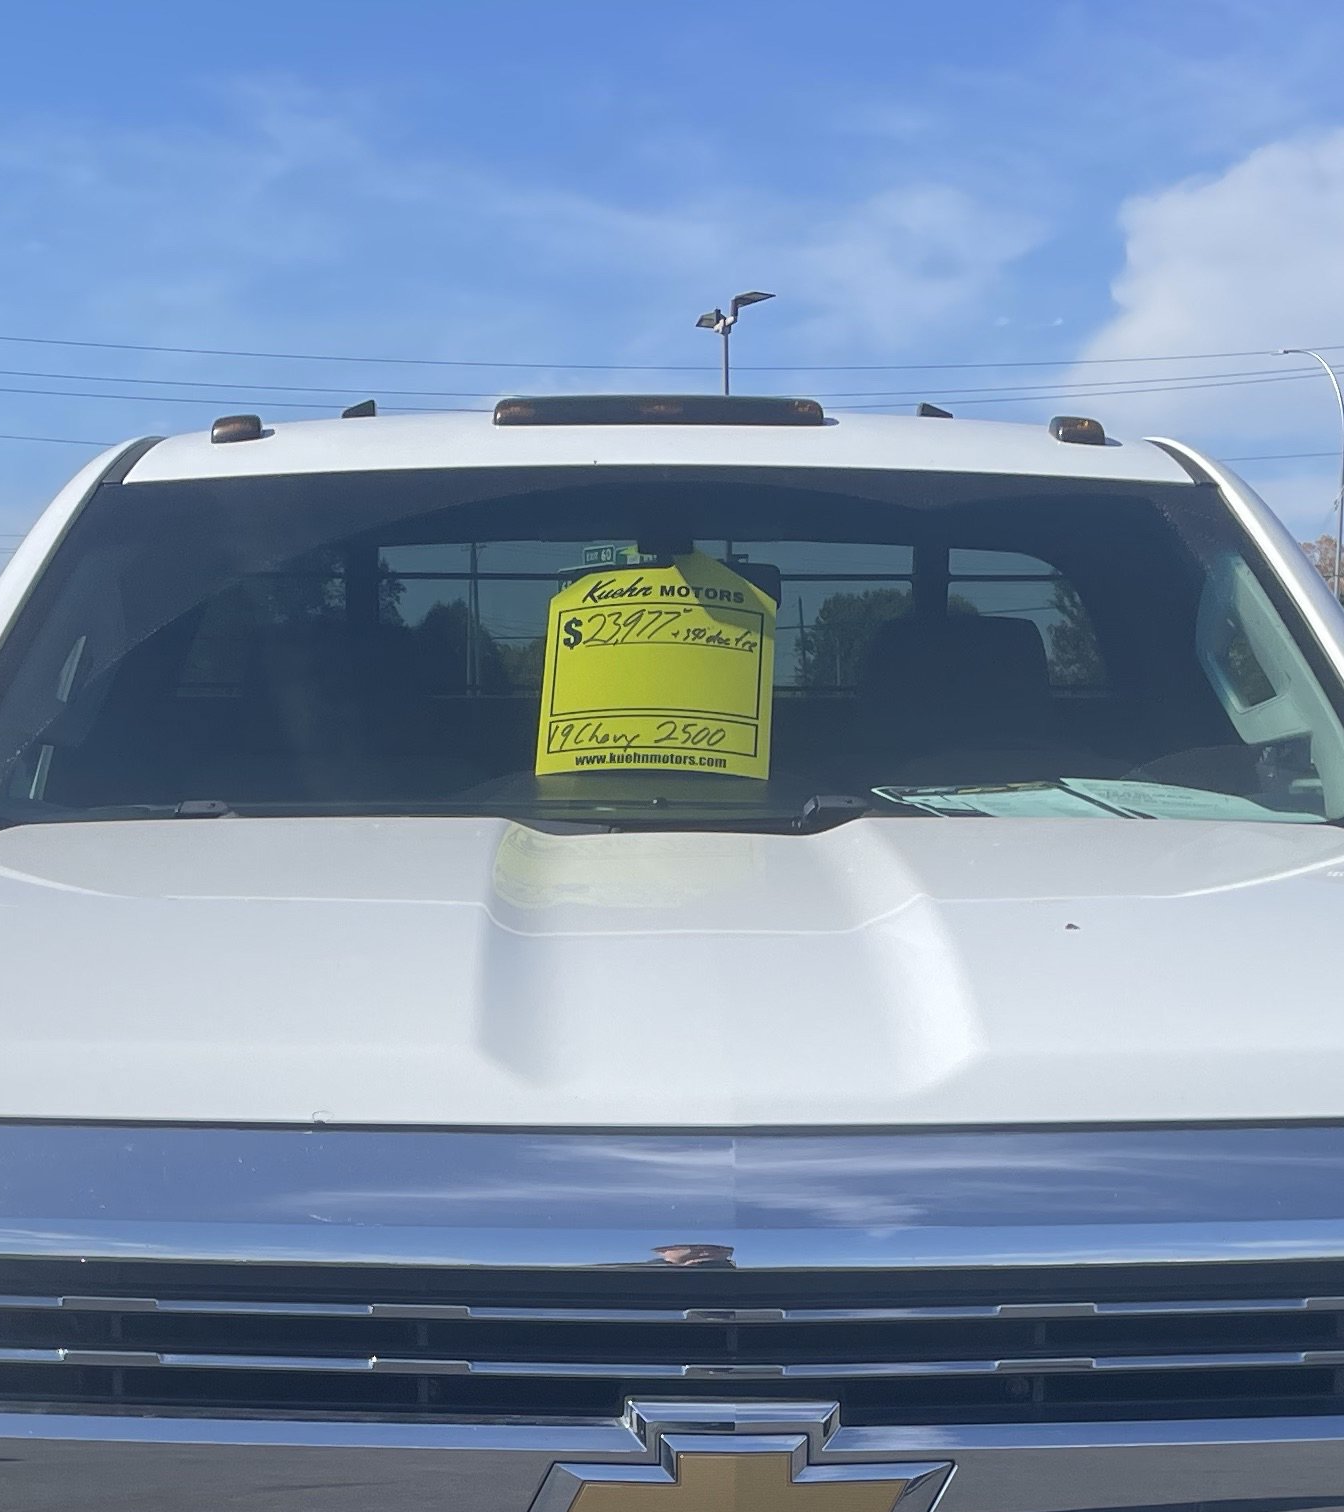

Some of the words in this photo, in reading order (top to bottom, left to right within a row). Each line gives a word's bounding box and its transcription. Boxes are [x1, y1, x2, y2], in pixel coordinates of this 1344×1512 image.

[600, 548, 612, 562] 60
[582, 577, 654, 604] Kuehn
[659, 584, 745, 604] MOTORS
[653, 720, 726, 747] 2500
[575, 751, 727, 769] www.kuehnmotors.com
